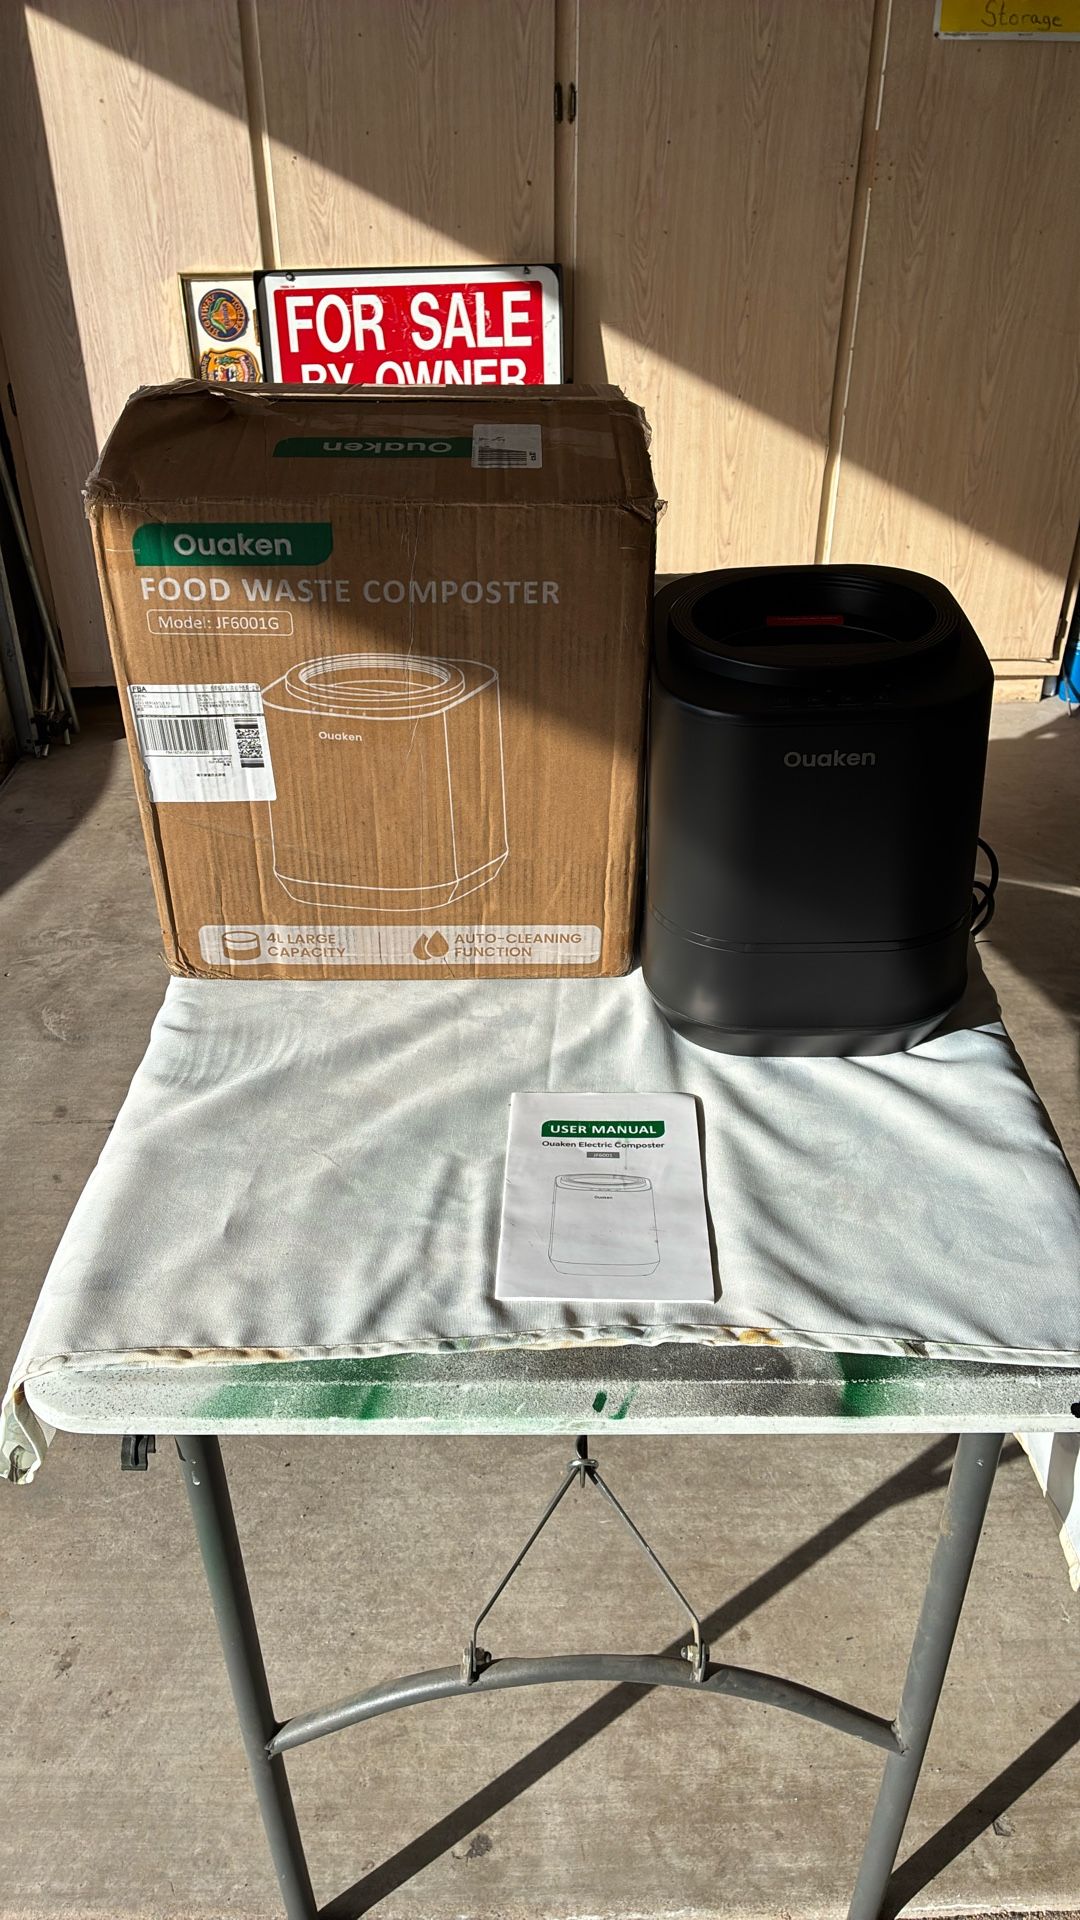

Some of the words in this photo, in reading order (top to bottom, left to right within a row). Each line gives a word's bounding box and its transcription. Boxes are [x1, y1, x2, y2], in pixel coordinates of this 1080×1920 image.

[981, 0, 1063, 30] Storage
[285, 294, 386, 353] FOR
[410, 290, 533, 352] SALE
[322, 440, 453, 454] Ouaken
[173, 533, 293, 557] Ouaken
[140, 577, 231, 601] FOOD
[241, 578, 351, 603] WASTE
[363, 580, 560, 605] COMPOSTER
[158, 615, 212, 630] Model:
[216, 616, 279, 630] JF6001G
[318, 731, 363, 741] Ouaken
[784, 750, 876, 767] Ouaken
[266, 933, 283, 944] 4L
[287, 933, 337, 945] LARGE
[455, 933, 582, 945] AUTO-CLEANING
[266, 946, 347, 959] CAPACITY
[455, 946, 533, 958] FUNCTION
[550, 1124, 587, 1134] USER
[591, 1124, 657, 1134] MANUAL
